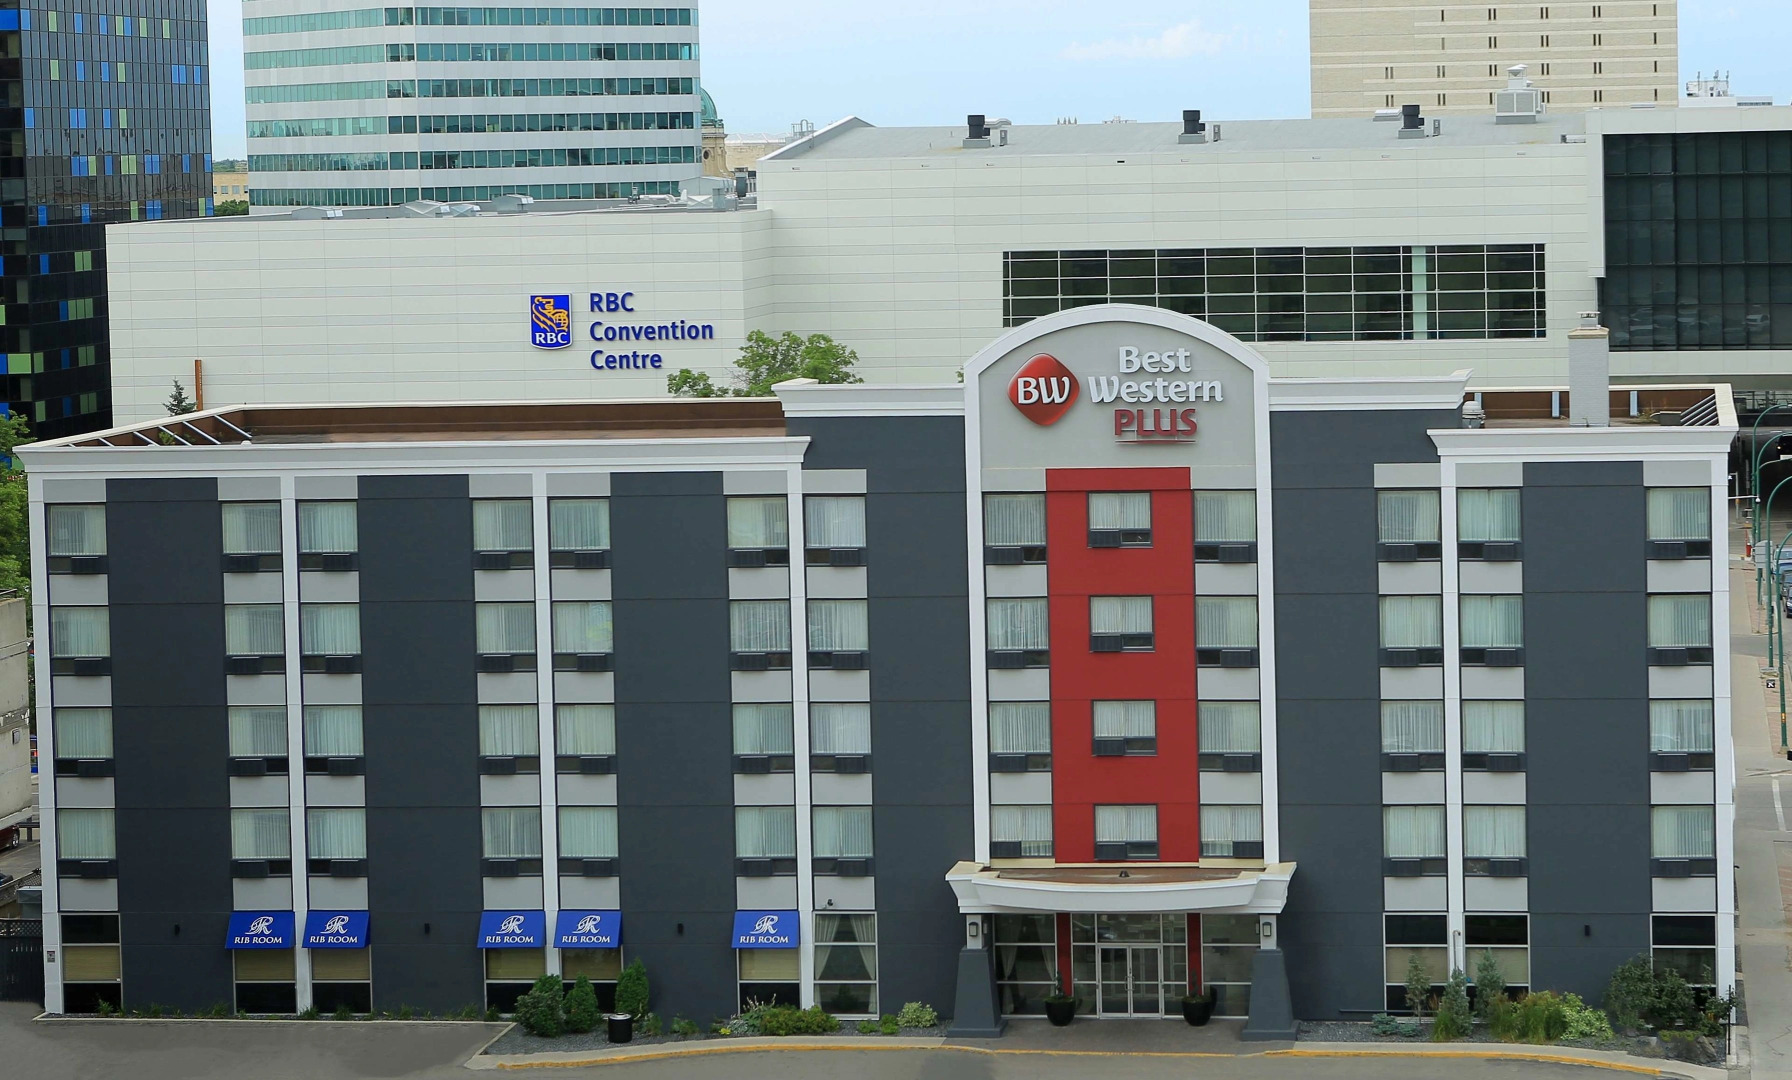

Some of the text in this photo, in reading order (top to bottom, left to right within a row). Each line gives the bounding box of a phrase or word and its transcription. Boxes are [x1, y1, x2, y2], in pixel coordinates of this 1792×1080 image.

[590, 292, 634, 312] RBC
[535, 332, 568, 344] RBC
[590, 320, 714, 342] Convention
[590, 350, 663, 370] Centre
[1119, 346, 1192, 374] Best
[1017, 376, 1070, 405] BW
[1088, 376, 1224, 403] Western
[1114, 408, 1198, 437] PLUS
[234, 936, 282, 944] RIB ROOM
[309, 935, 358, 943] RIB ROOM
[485, 935, 534, 943] RIB ROOM
[561, 935, 611, 943] RIB ROOM
[739, 936, 789, 944] RIB ROOM
